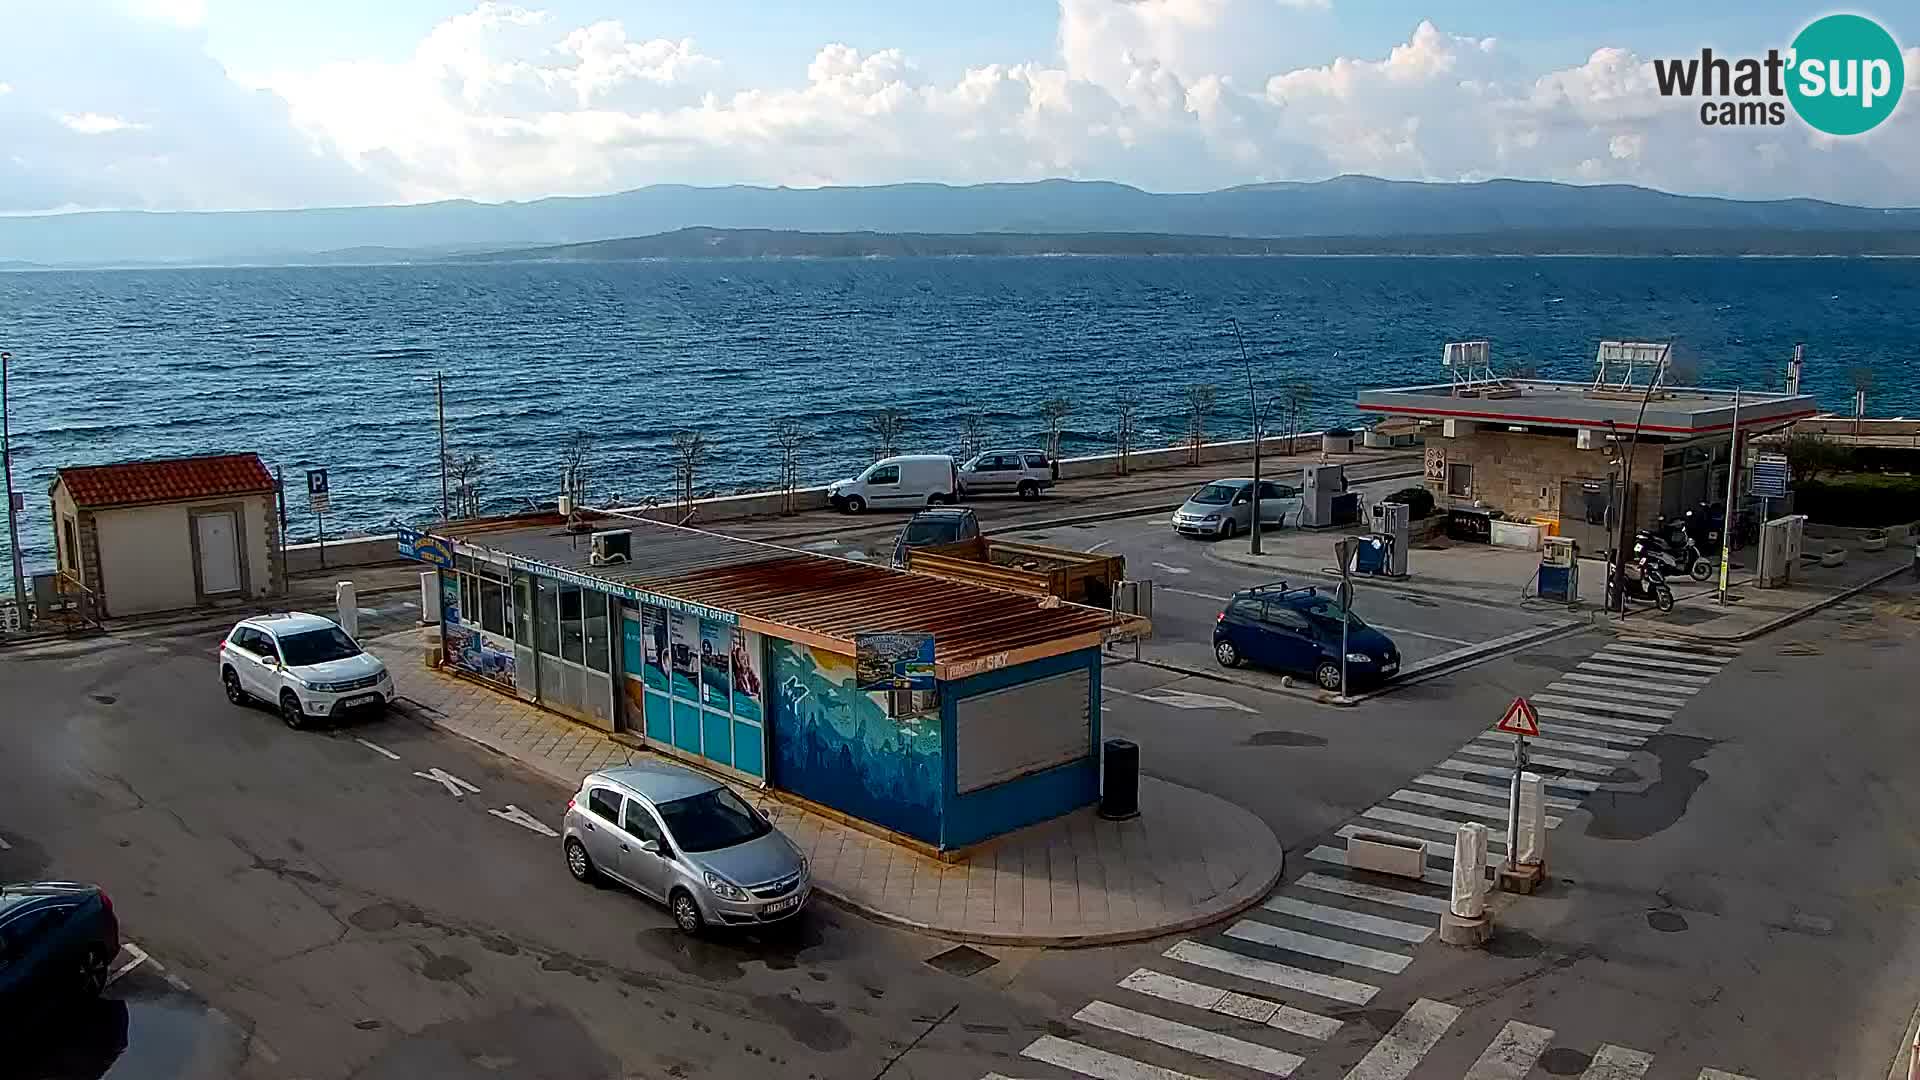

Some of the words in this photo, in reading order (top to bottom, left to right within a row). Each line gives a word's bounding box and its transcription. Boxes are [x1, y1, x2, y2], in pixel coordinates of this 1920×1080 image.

[312, 473, 323, 490] P
[596, 581, 625, 596] POSTAJA
[635, 590, 650, 603] BUS
[650, 596, 682, 611] STATION
[682, 602, 708, 617] TICKET
[709, 608, 736, 624] OFFICE
